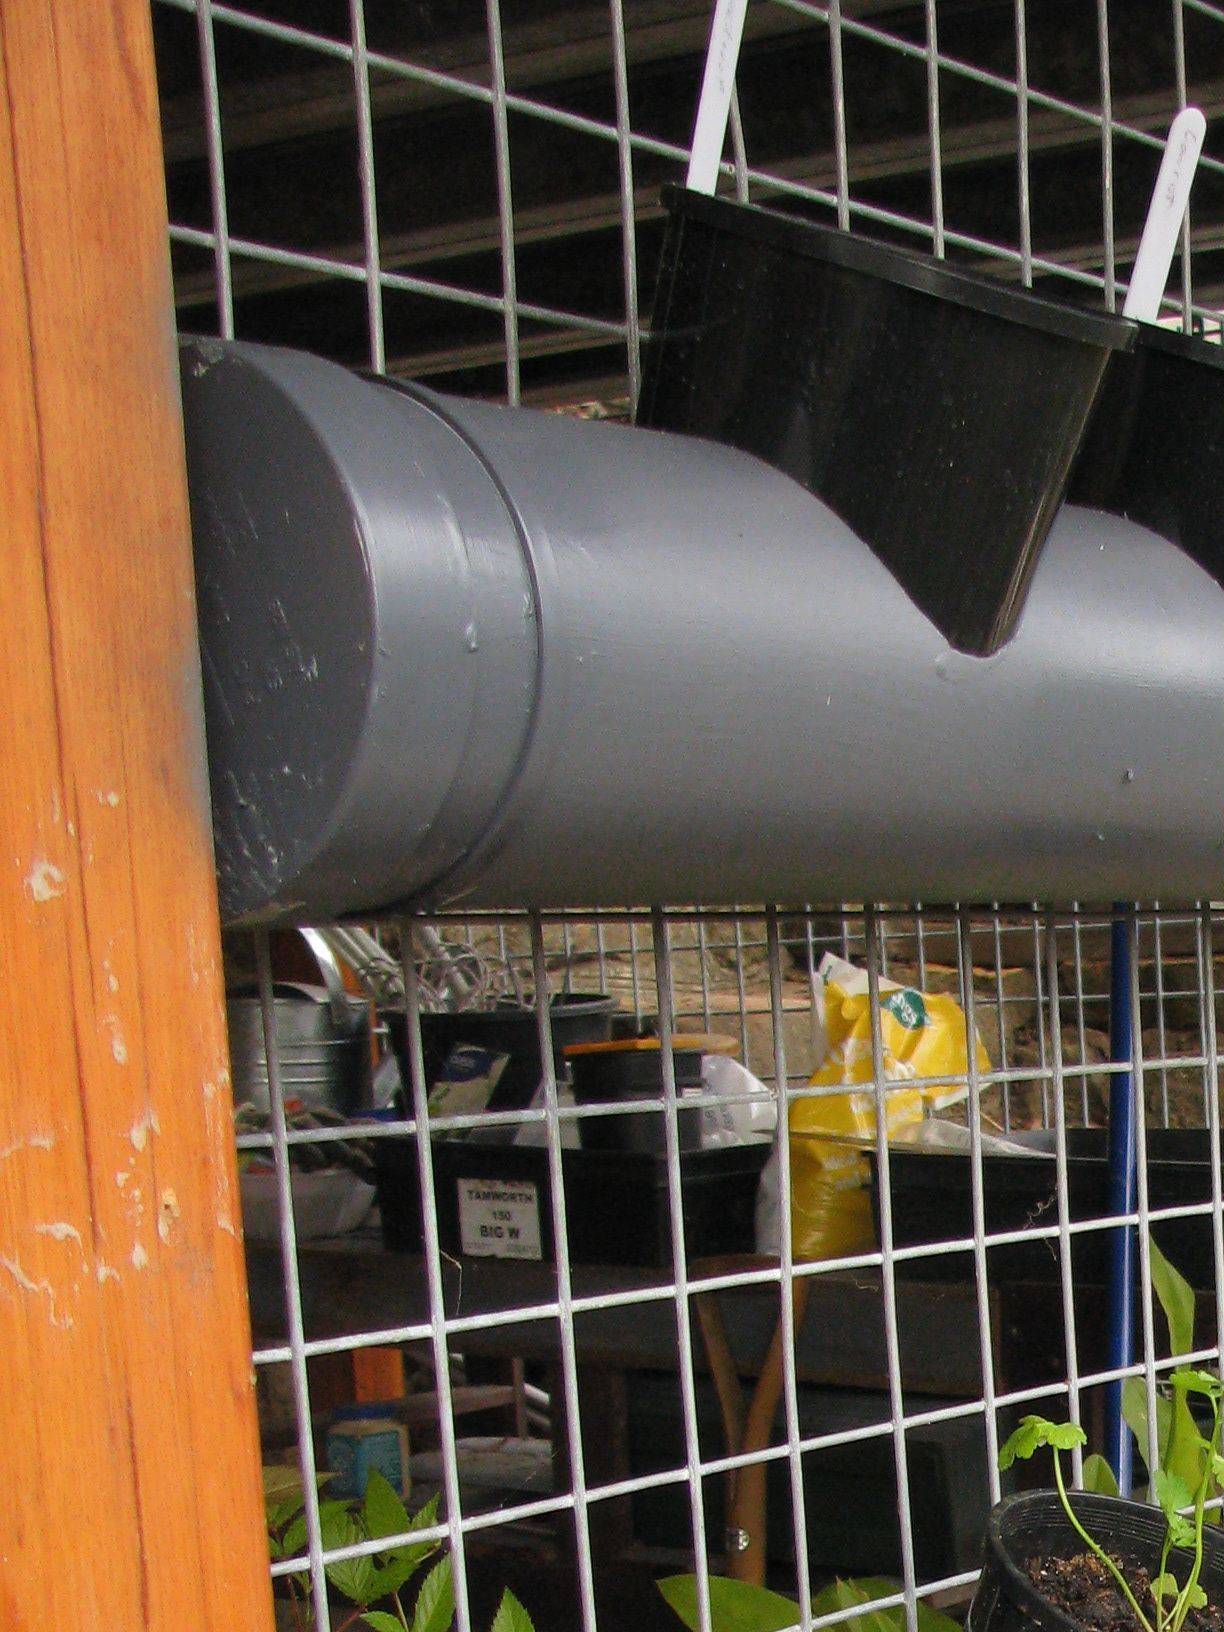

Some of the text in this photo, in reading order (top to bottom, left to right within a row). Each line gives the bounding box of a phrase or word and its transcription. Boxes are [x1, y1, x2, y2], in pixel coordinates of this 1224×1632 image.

[468, 1190, 533, 1202] TAMWORTH
[480, 1226, 519, 1239] BIG W
